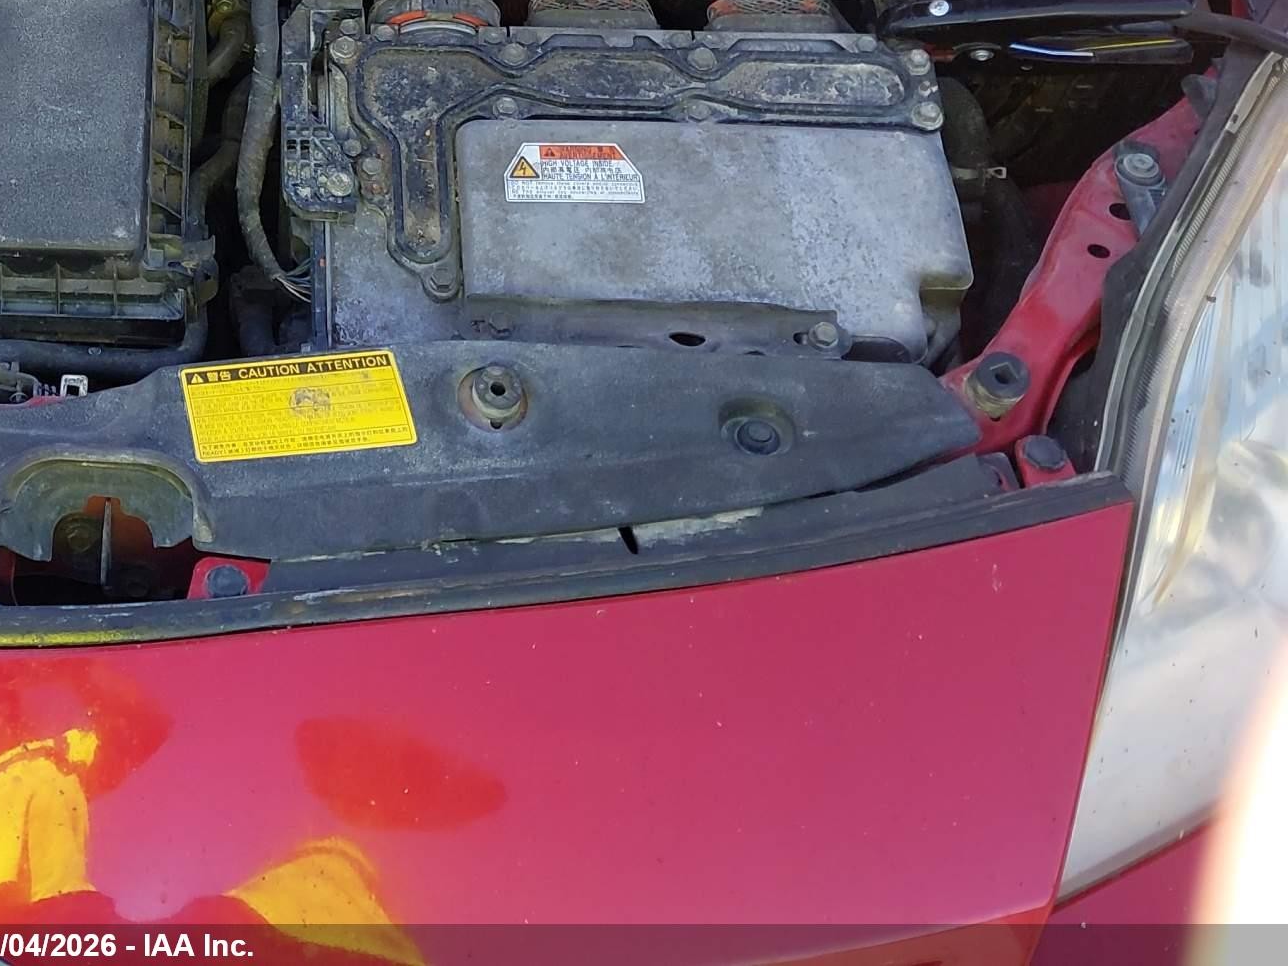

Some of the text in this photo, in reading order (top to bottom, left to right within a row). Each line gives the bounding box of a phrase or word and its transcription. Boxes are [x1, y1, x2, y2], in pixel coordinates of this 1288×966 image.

[592, 160, 612, 168] INSIDE
[566, 173, 592, 181] TENSION
[206, 355, 387, 383] 警告 CAUTION ATTENTION
